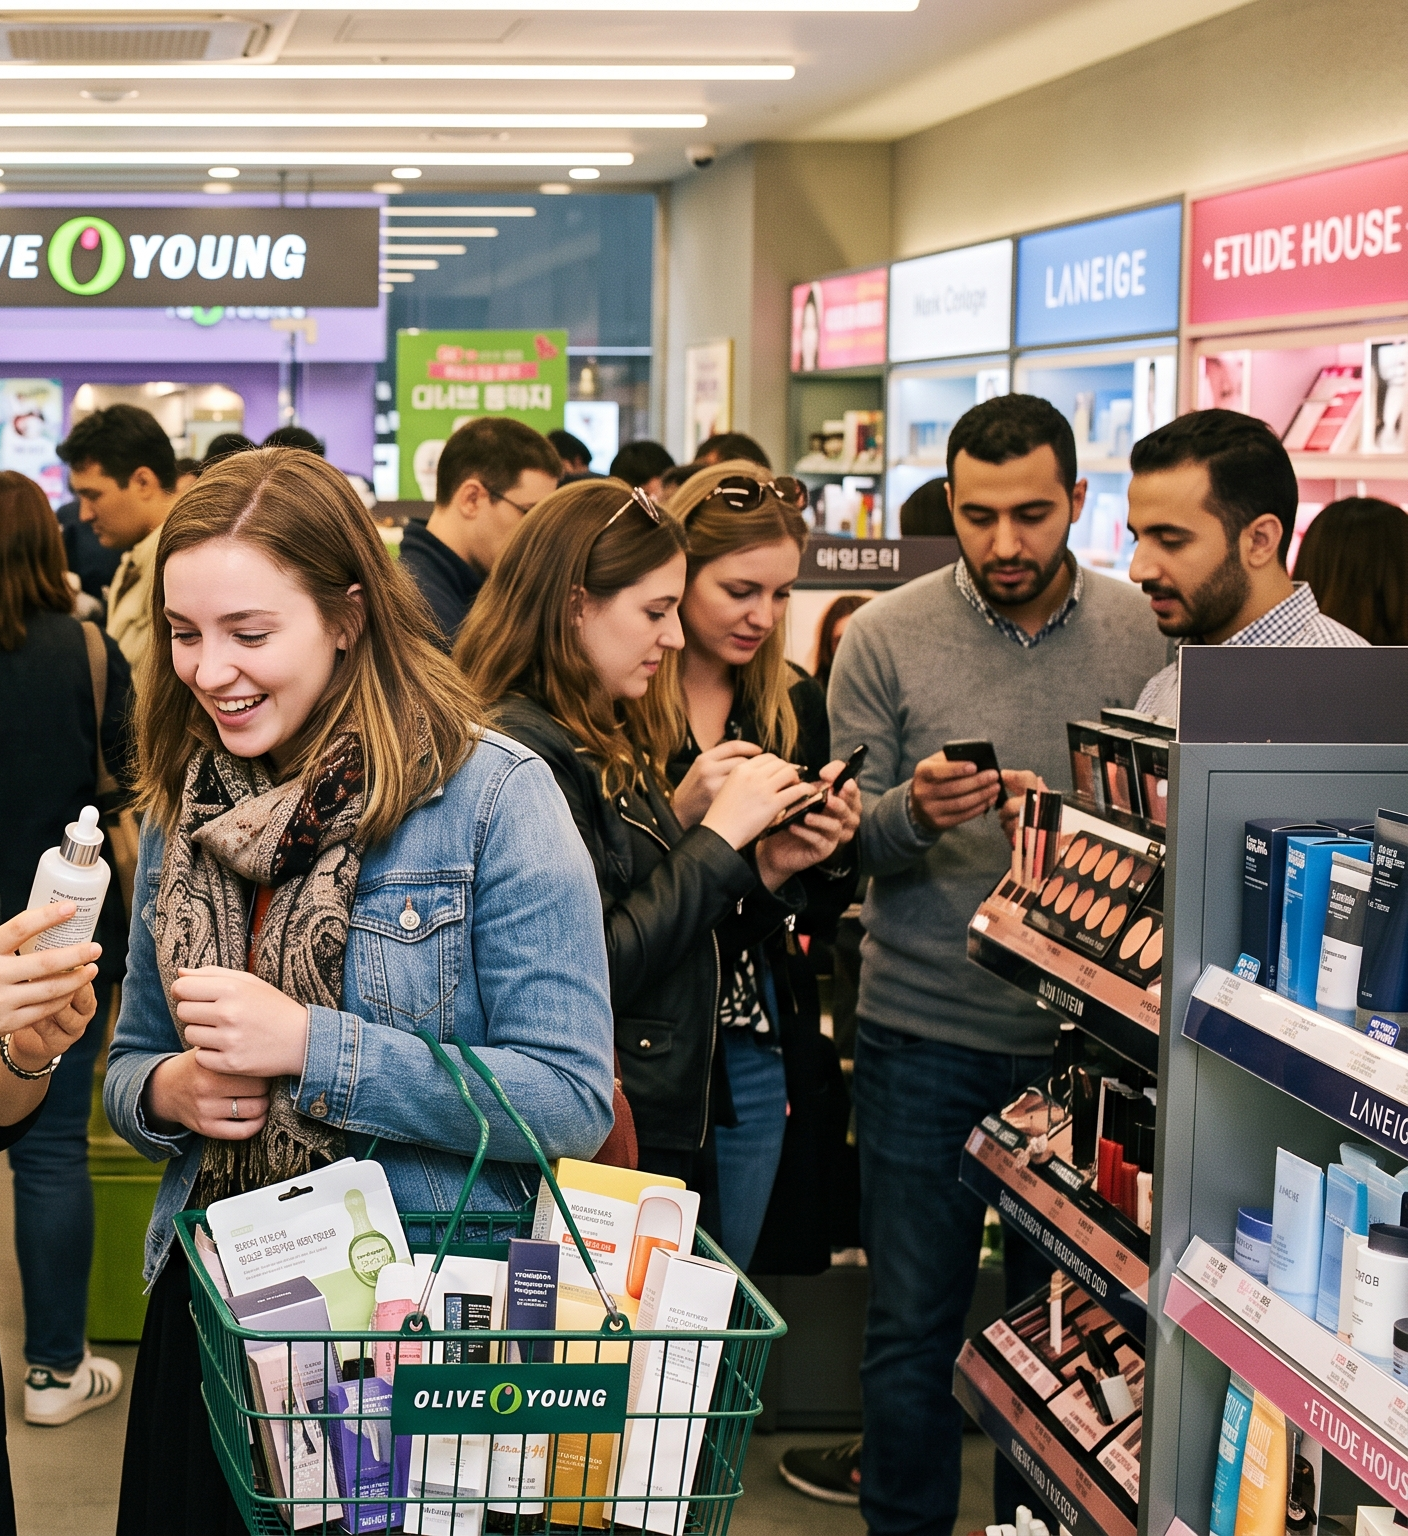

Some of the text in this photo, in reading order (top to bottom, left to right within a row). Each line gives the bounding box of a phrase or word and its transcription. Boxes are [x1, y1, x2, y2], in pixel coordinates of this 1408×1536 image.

[129, 234, 307, 281] YOUNG
[1213, 205, 1403, 281] ETUDE HOUSE
[1045, 249, 1146, 310] LANEIGE
[413, 1389, 608, 1409] OLIVE YOUNG
[1308, 1398, 1361, 1461] ETUDE
